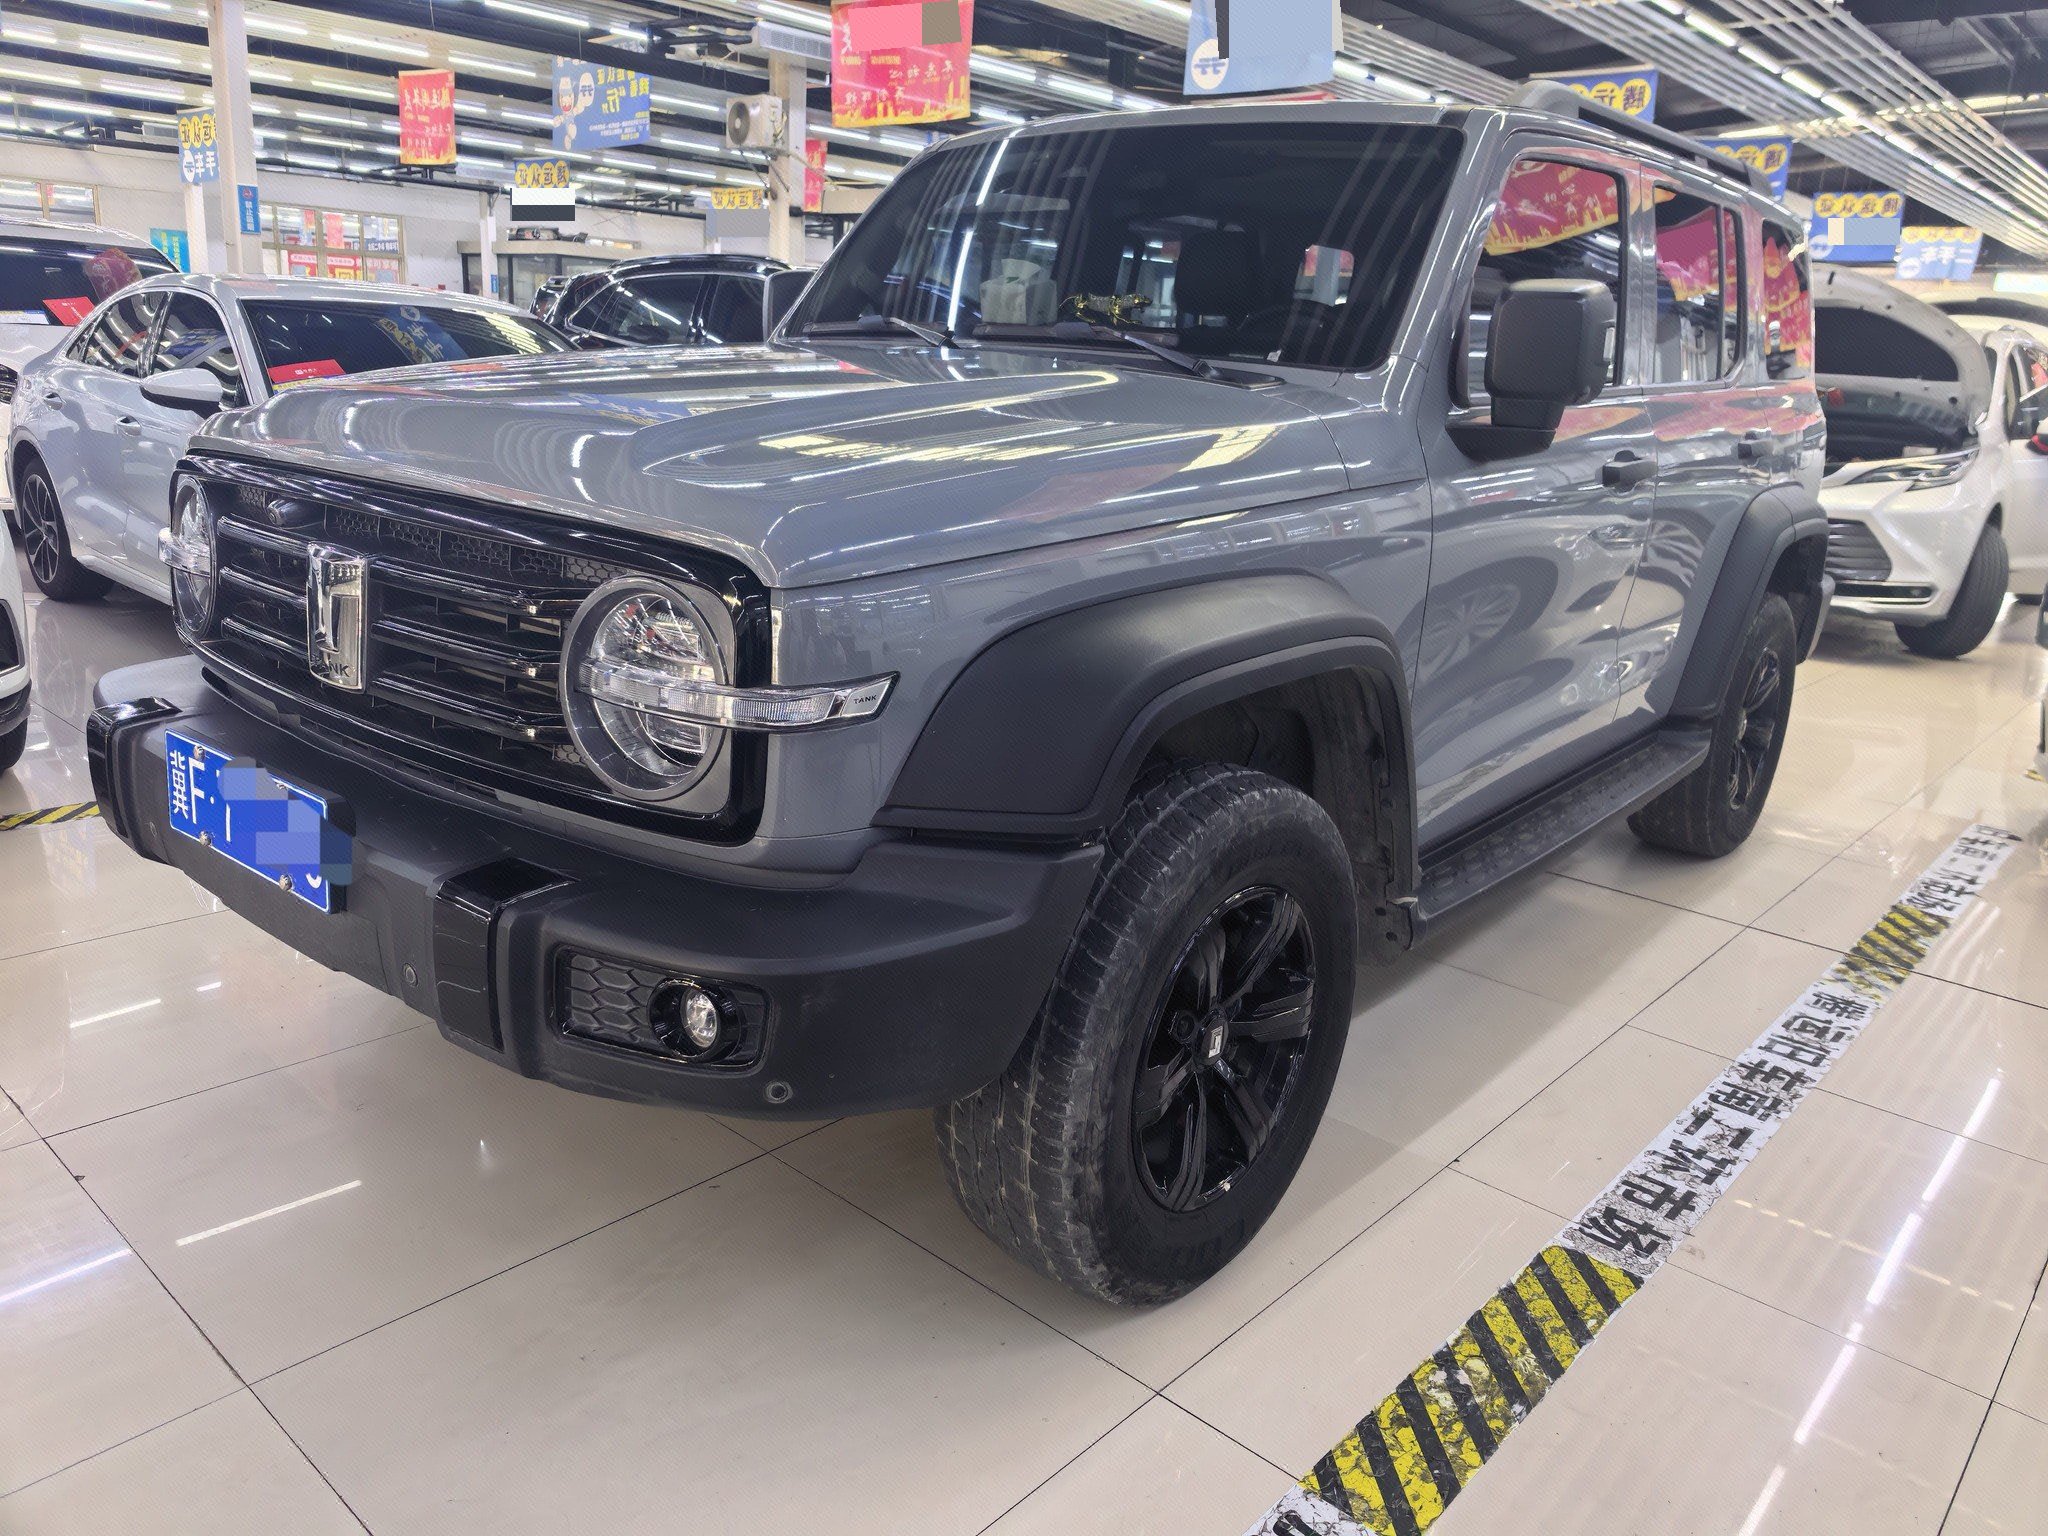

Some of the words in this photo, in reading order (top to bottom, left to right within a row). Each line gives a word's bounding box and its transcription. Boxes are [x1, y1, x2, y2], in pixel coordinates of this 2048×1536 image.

[853, 694, 877, 705] TANK
[1578, 989, 1869, 1260] 腾运旧车南二环市场
